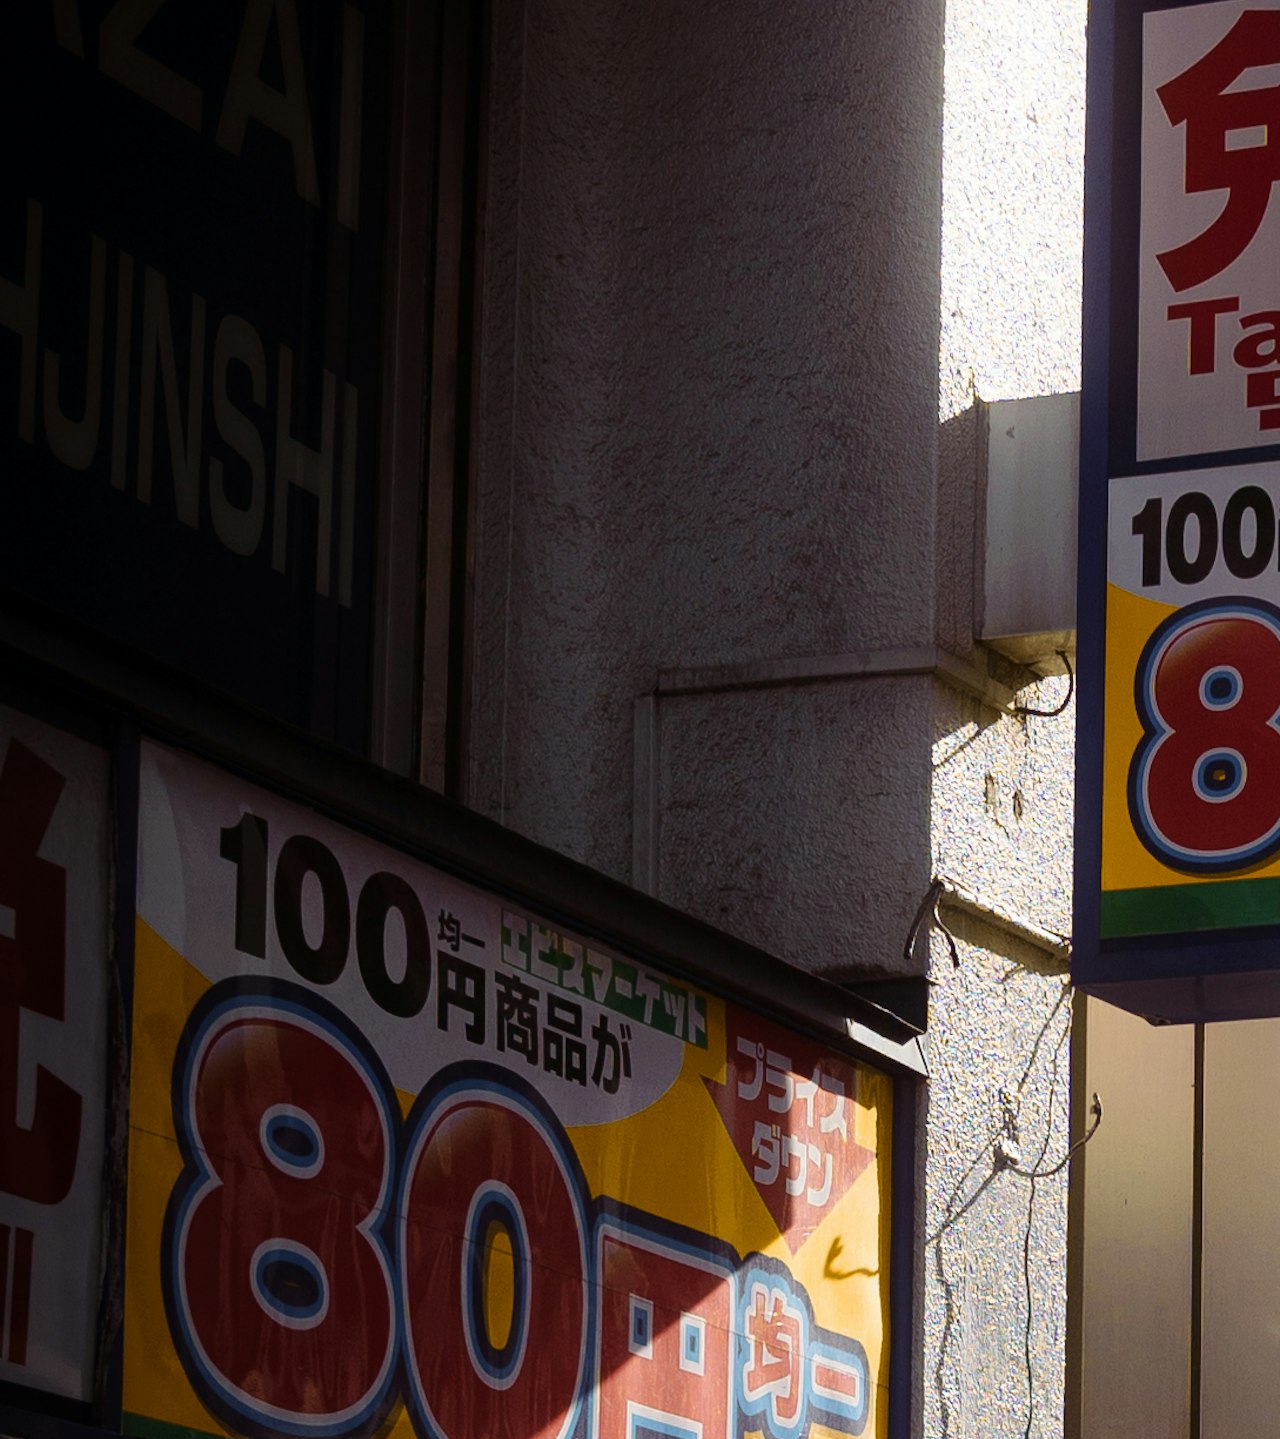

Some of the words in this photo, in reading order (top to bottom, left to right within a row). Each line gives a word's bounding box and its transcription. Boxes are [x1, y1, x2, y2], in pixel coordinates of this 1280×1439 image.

[500, 909, 708, 1049] エビスマーケット
[736, 1037, 848, 1140] プライス
[750, 1123, 832, 1208] ダウン
